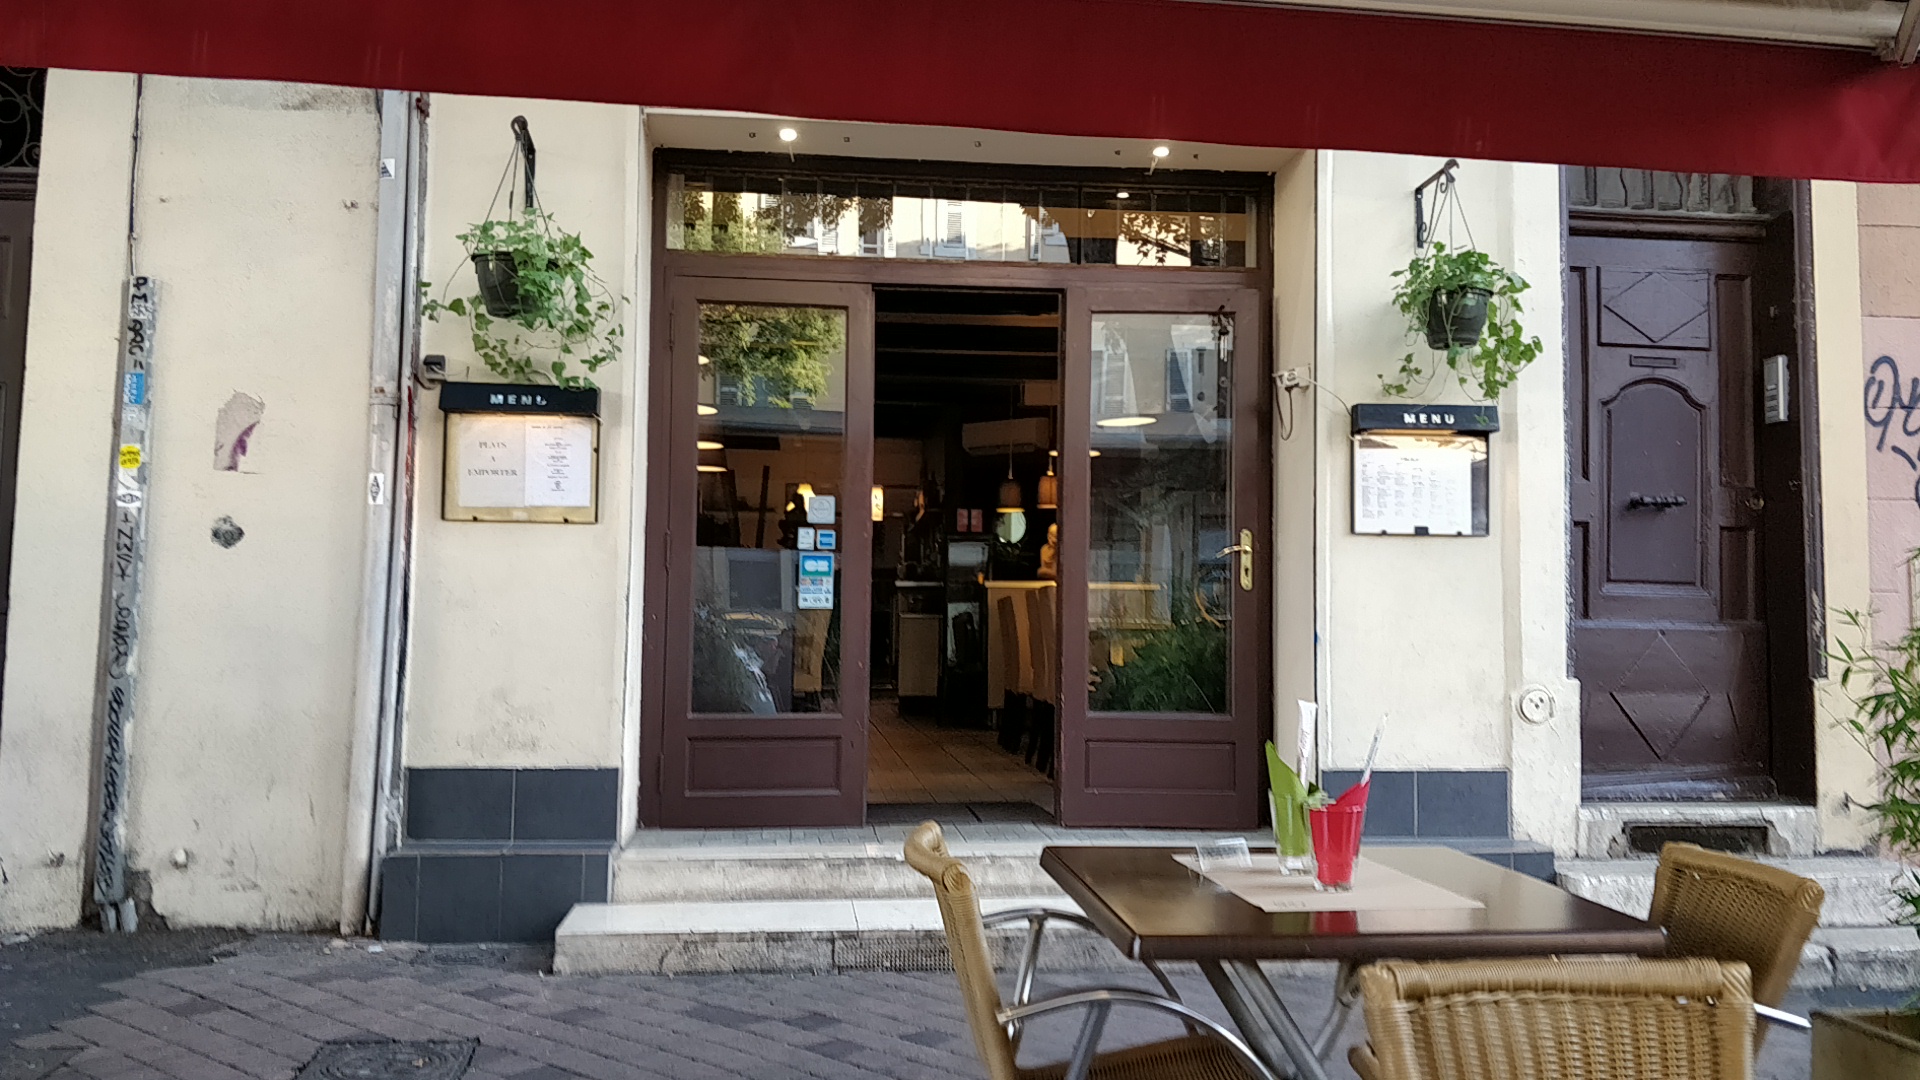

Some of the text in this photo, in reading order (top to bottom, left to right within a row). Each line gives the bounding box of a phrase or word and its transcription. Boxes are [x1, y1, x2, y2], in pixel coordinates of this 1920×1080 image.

[1403, 413, 1455, 425] MENU
[478, 441, 507, 449] PLATS
[467, 469, 518, 477] EMPORTER
